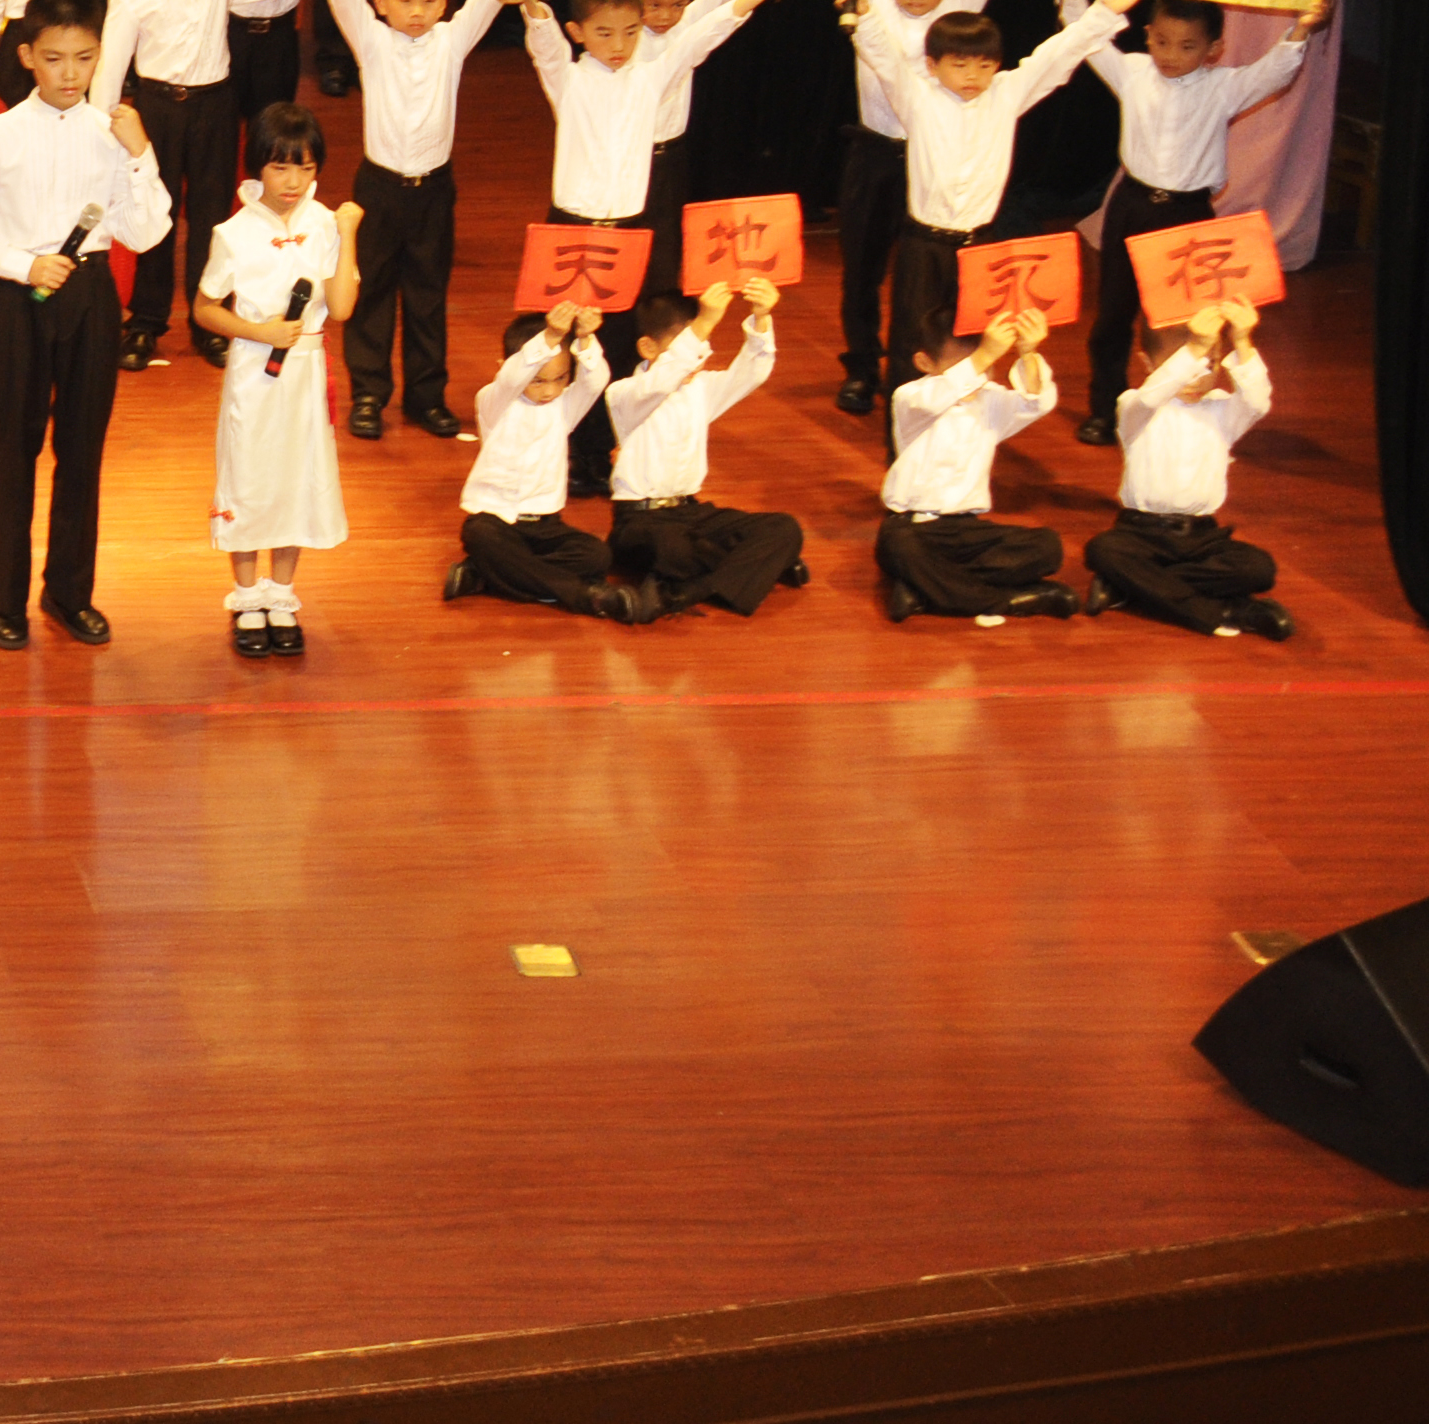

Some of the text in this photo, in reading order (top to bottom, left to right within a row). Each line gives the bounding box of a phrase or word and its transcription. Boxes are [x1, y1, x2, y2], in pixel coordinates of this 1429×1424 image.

[544, 244, 621, 299] 天
[707, 216, 780, 273] 地
[1166, 237, 1250, 300] 存
